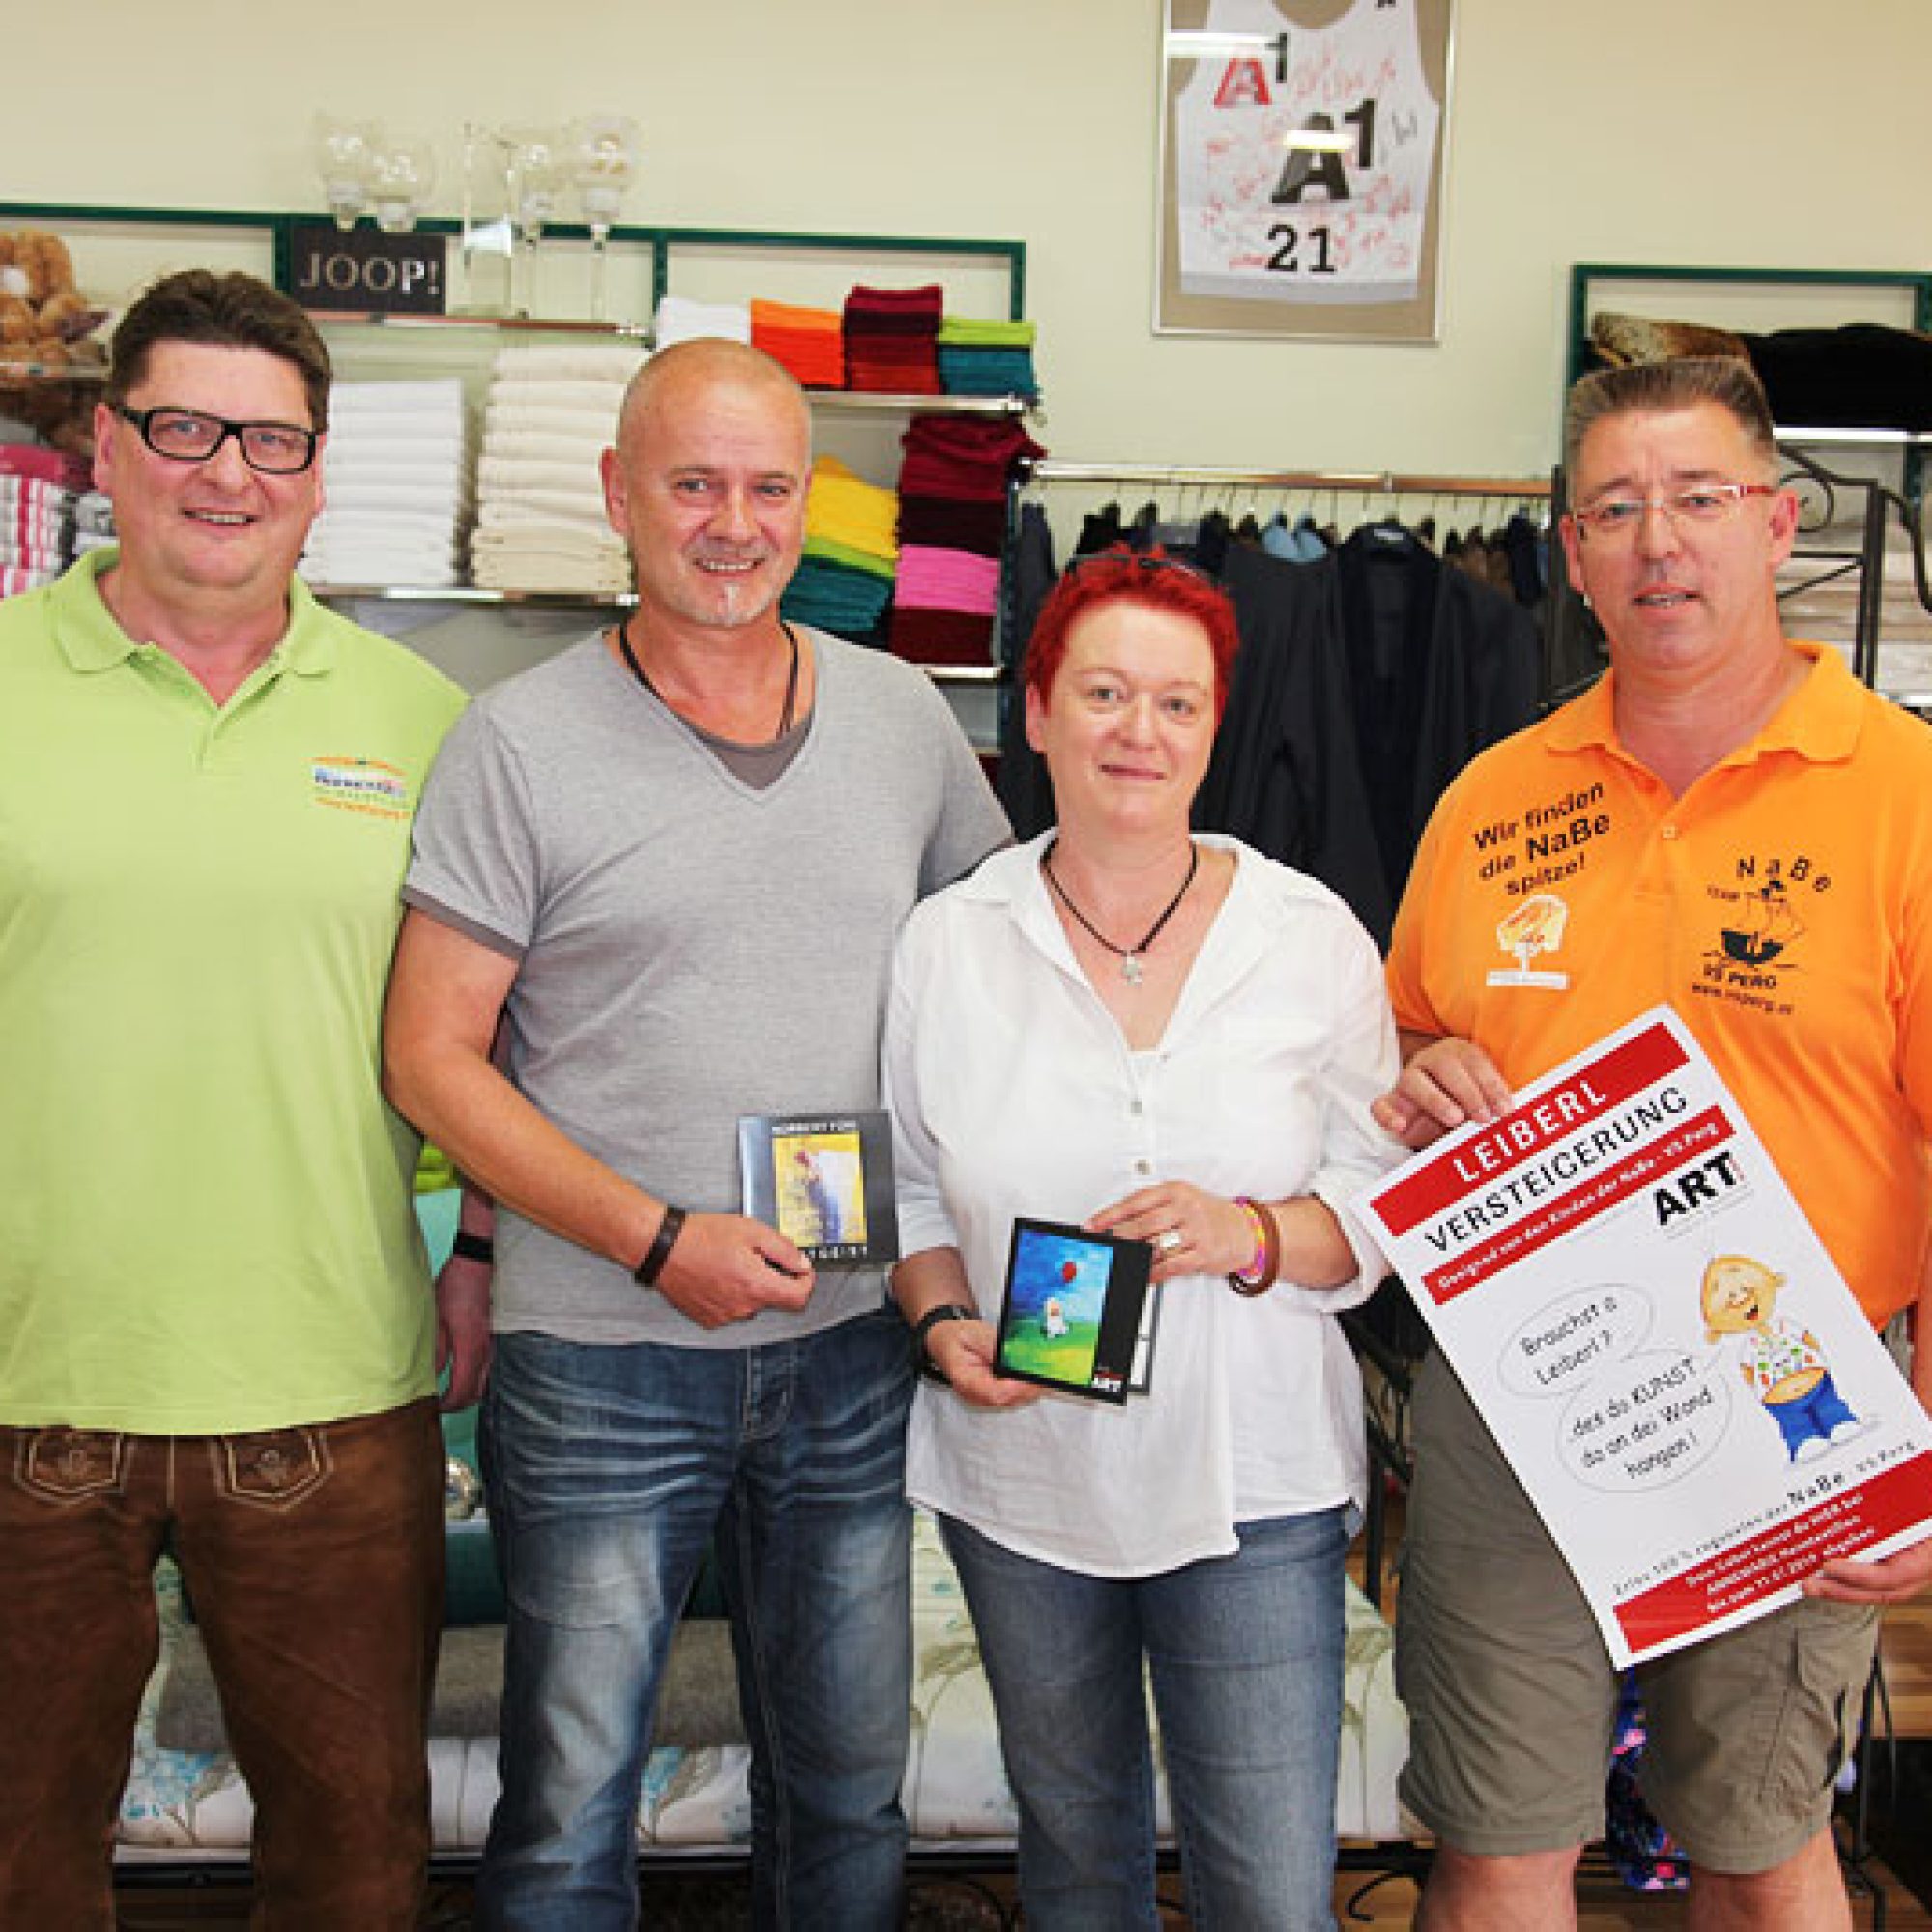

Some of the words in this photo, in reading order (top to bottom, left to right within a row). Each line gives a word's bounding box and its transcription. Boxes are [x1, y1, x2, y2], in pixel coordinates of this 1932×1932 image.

[1270, 98, 1376, 204] A1
[298, 252, 440, 296] JOOP!
[1265, 224, 1337, 273] 21
[1474, 822, 1519, 850] Wir
[1525, 782, 1604, 828] finden
[1478, 855, 1516, 879] die
[1525, 814, 1610, 864] NaBe
[1453, 1080, 1607, 1182] LEIBERL
[1424, 1087, 1687, 1252] VERSTEIGERUNG
[1655, 1151, 1737, 1227] ART
[1519, 1304, 1600, 1357] Brauchst
[1630, 1354, 1697, 1406] KUNST
